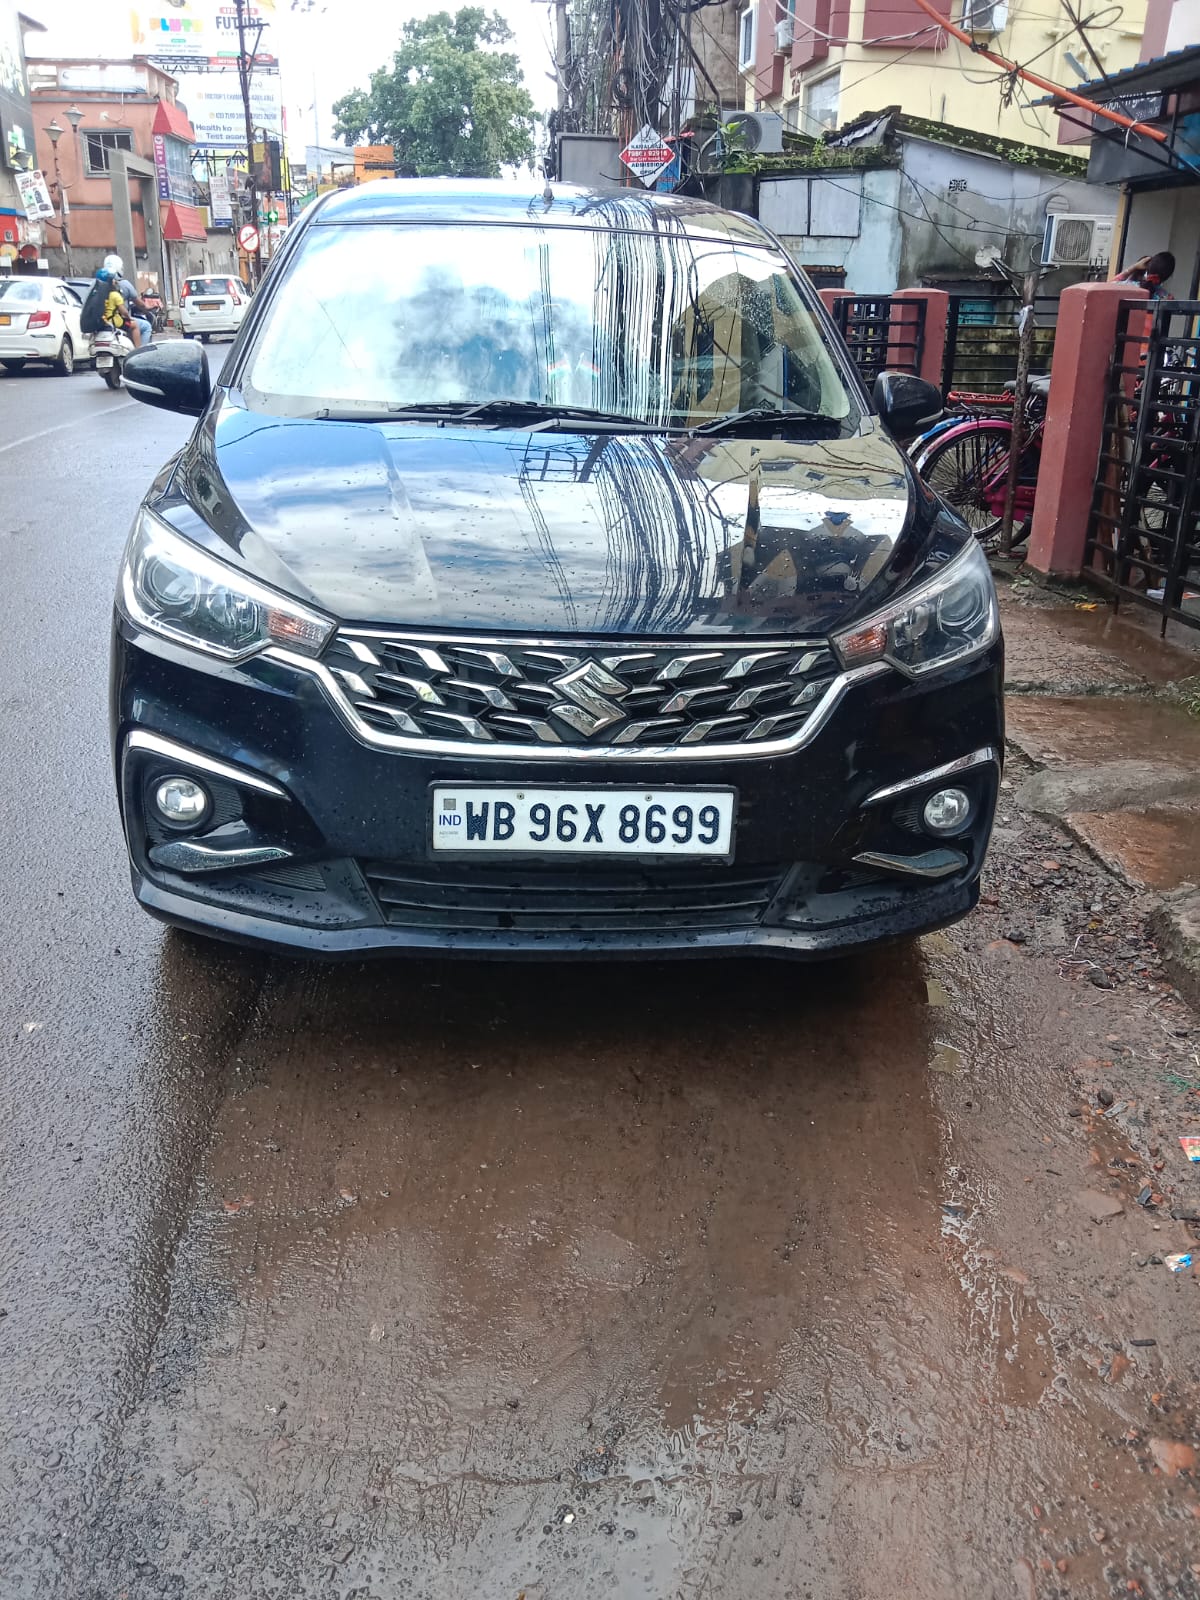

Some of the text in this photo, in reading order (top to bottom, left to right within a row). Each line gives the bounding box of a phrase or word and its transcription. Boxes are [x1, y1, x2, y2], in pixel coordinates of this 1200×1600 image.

[196, 123, 232, 132] Health ko
[205, 132, 223, 140] Test
[439, 815, 462, 826] IND
[465, 801, 720, 844] WB 96X 8699
